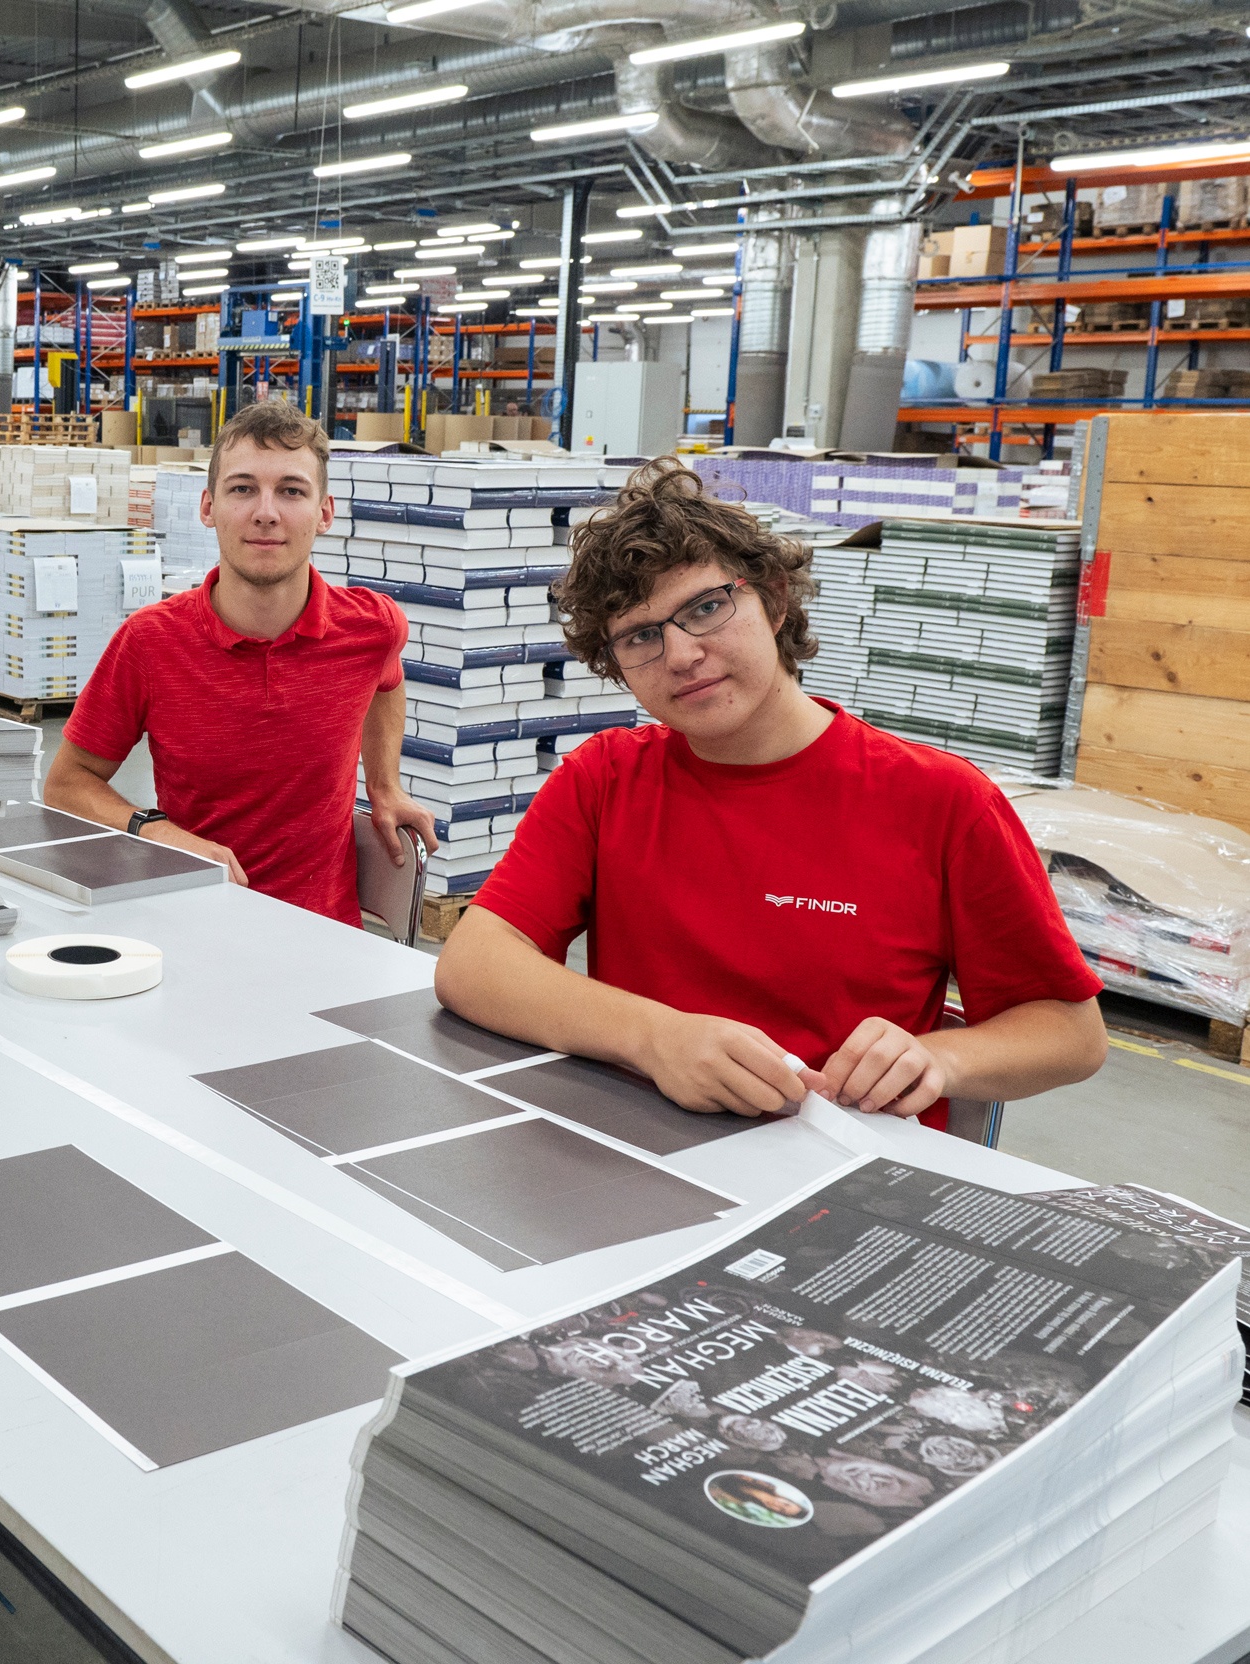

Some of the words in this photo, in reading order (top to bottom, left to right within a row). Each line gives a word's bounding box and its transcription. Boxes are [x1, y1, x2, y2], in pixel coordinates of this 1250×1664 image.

[131, 586, 155, 598] PUR
[795, 897, 857, 916] FINIDR
[1076, 1191, 1226, 1244] MEGHAN
[574, 1297, 726, 1366] MARCH
[630, 1320, 777, 1389] MEGHAN
[843, 1336, 920, 1371] KSIĘŻNICZKA
[711, 1354, 835, 1415] KSIĘŻNICZKA
[919, 1365, 974, 1392] ŻELAZNA
[770, 1378, 895, 1437] ŻELAZNA
[633, 1427, 707, 1466] MARCH
[640, 1437, 731, 1486] MEGHAN
